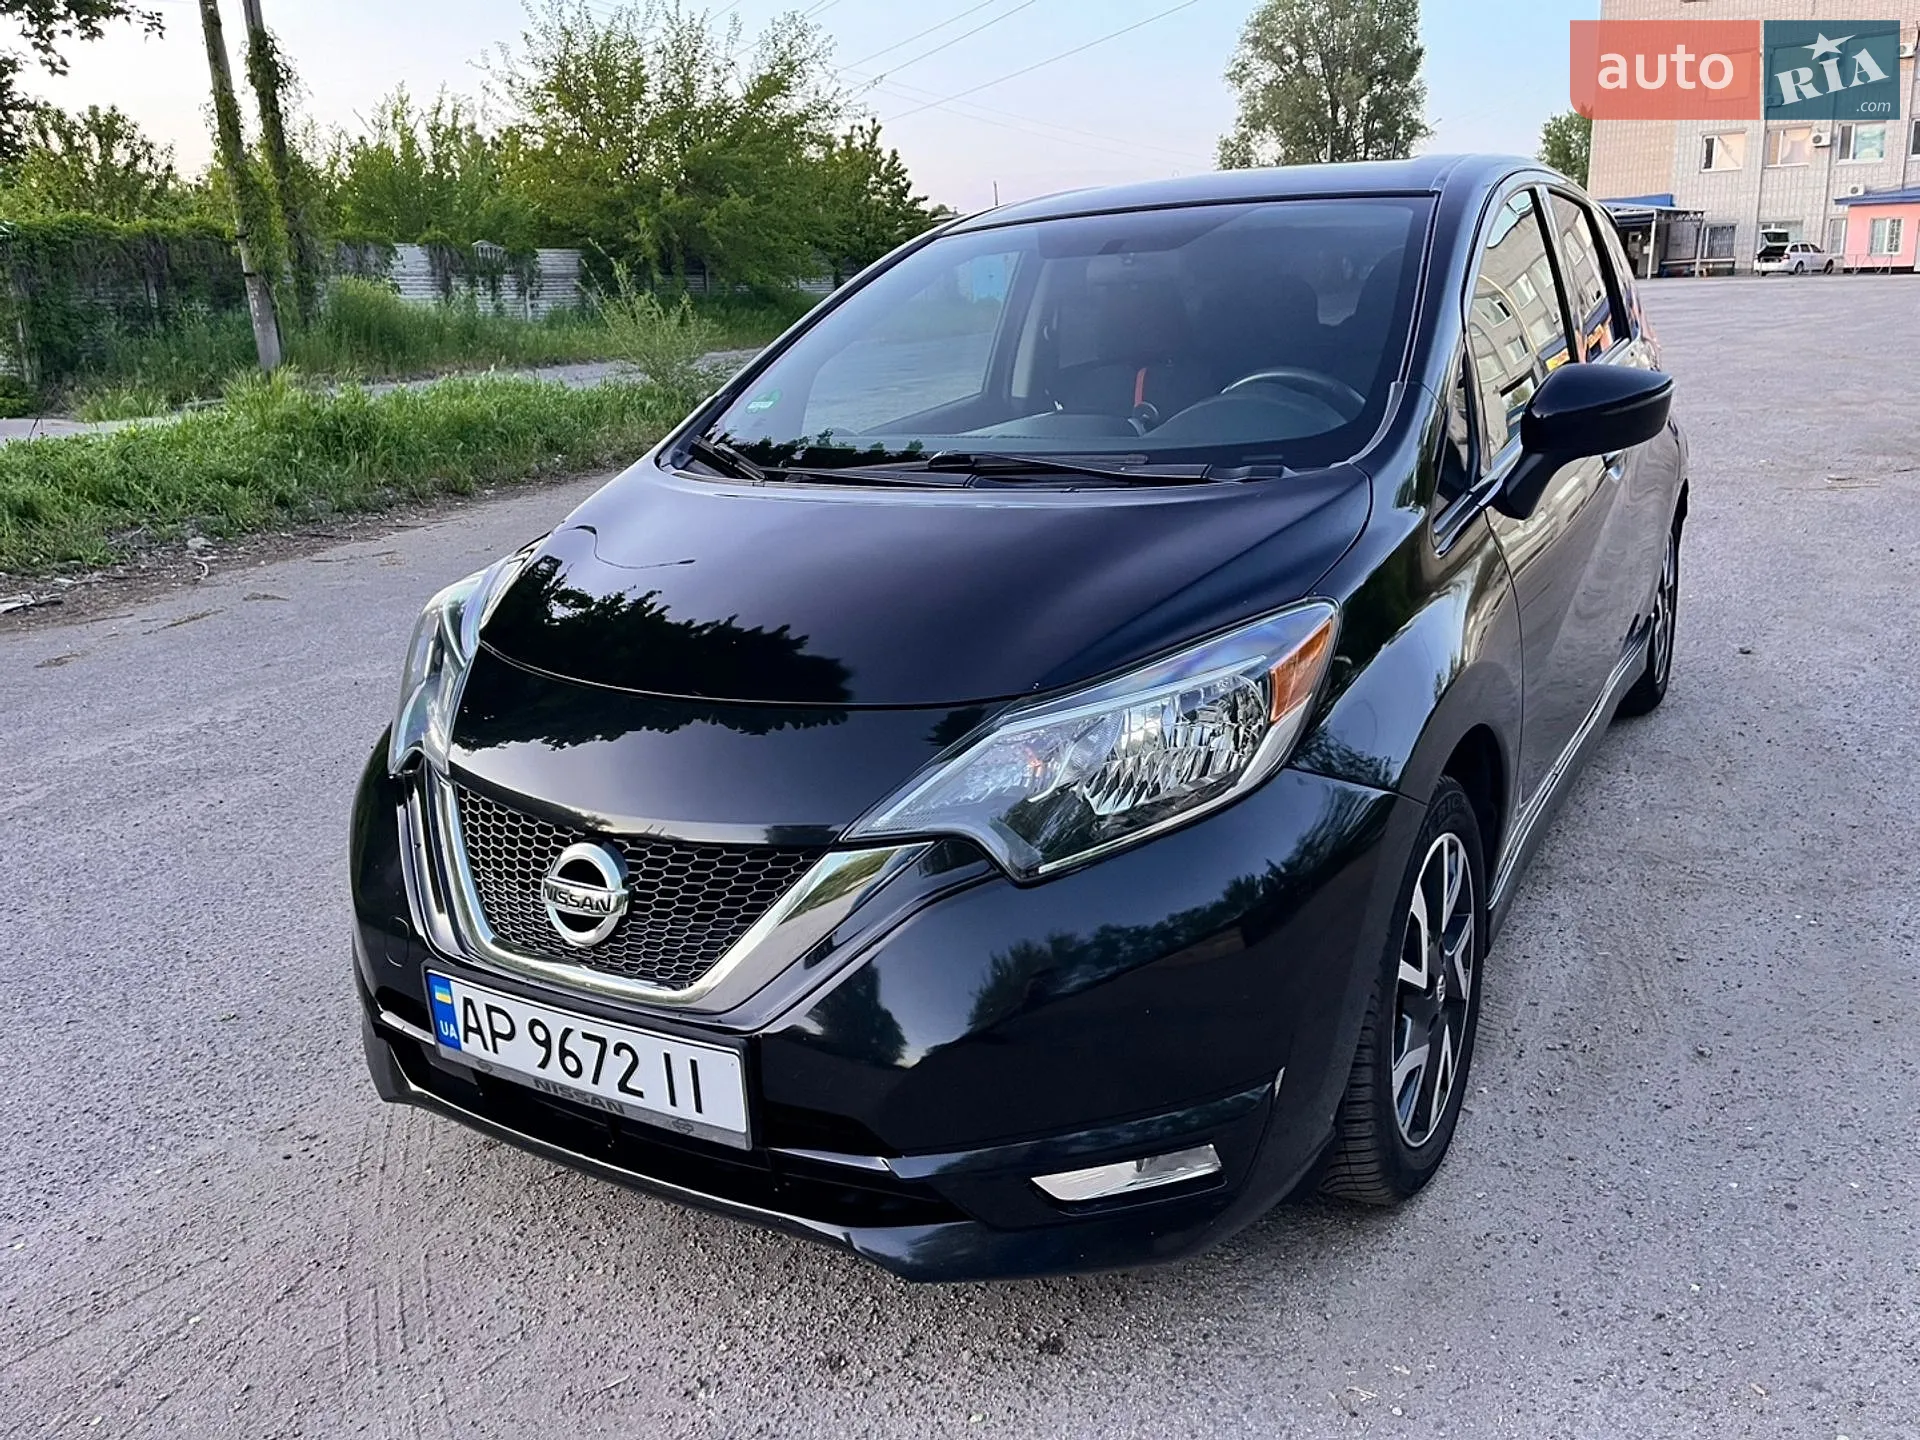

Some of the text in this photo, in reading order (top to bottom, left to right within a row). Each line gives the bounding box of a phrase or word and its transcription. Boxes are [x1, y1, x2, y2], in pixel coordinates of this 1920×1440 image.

[545, 886, 611, 914] NISSAN
[440, 1020, 458, 1040] UA
[463, 996, 703, 1114] AP 9672 II
[533, 1079, 625, 1115] NISSAN
